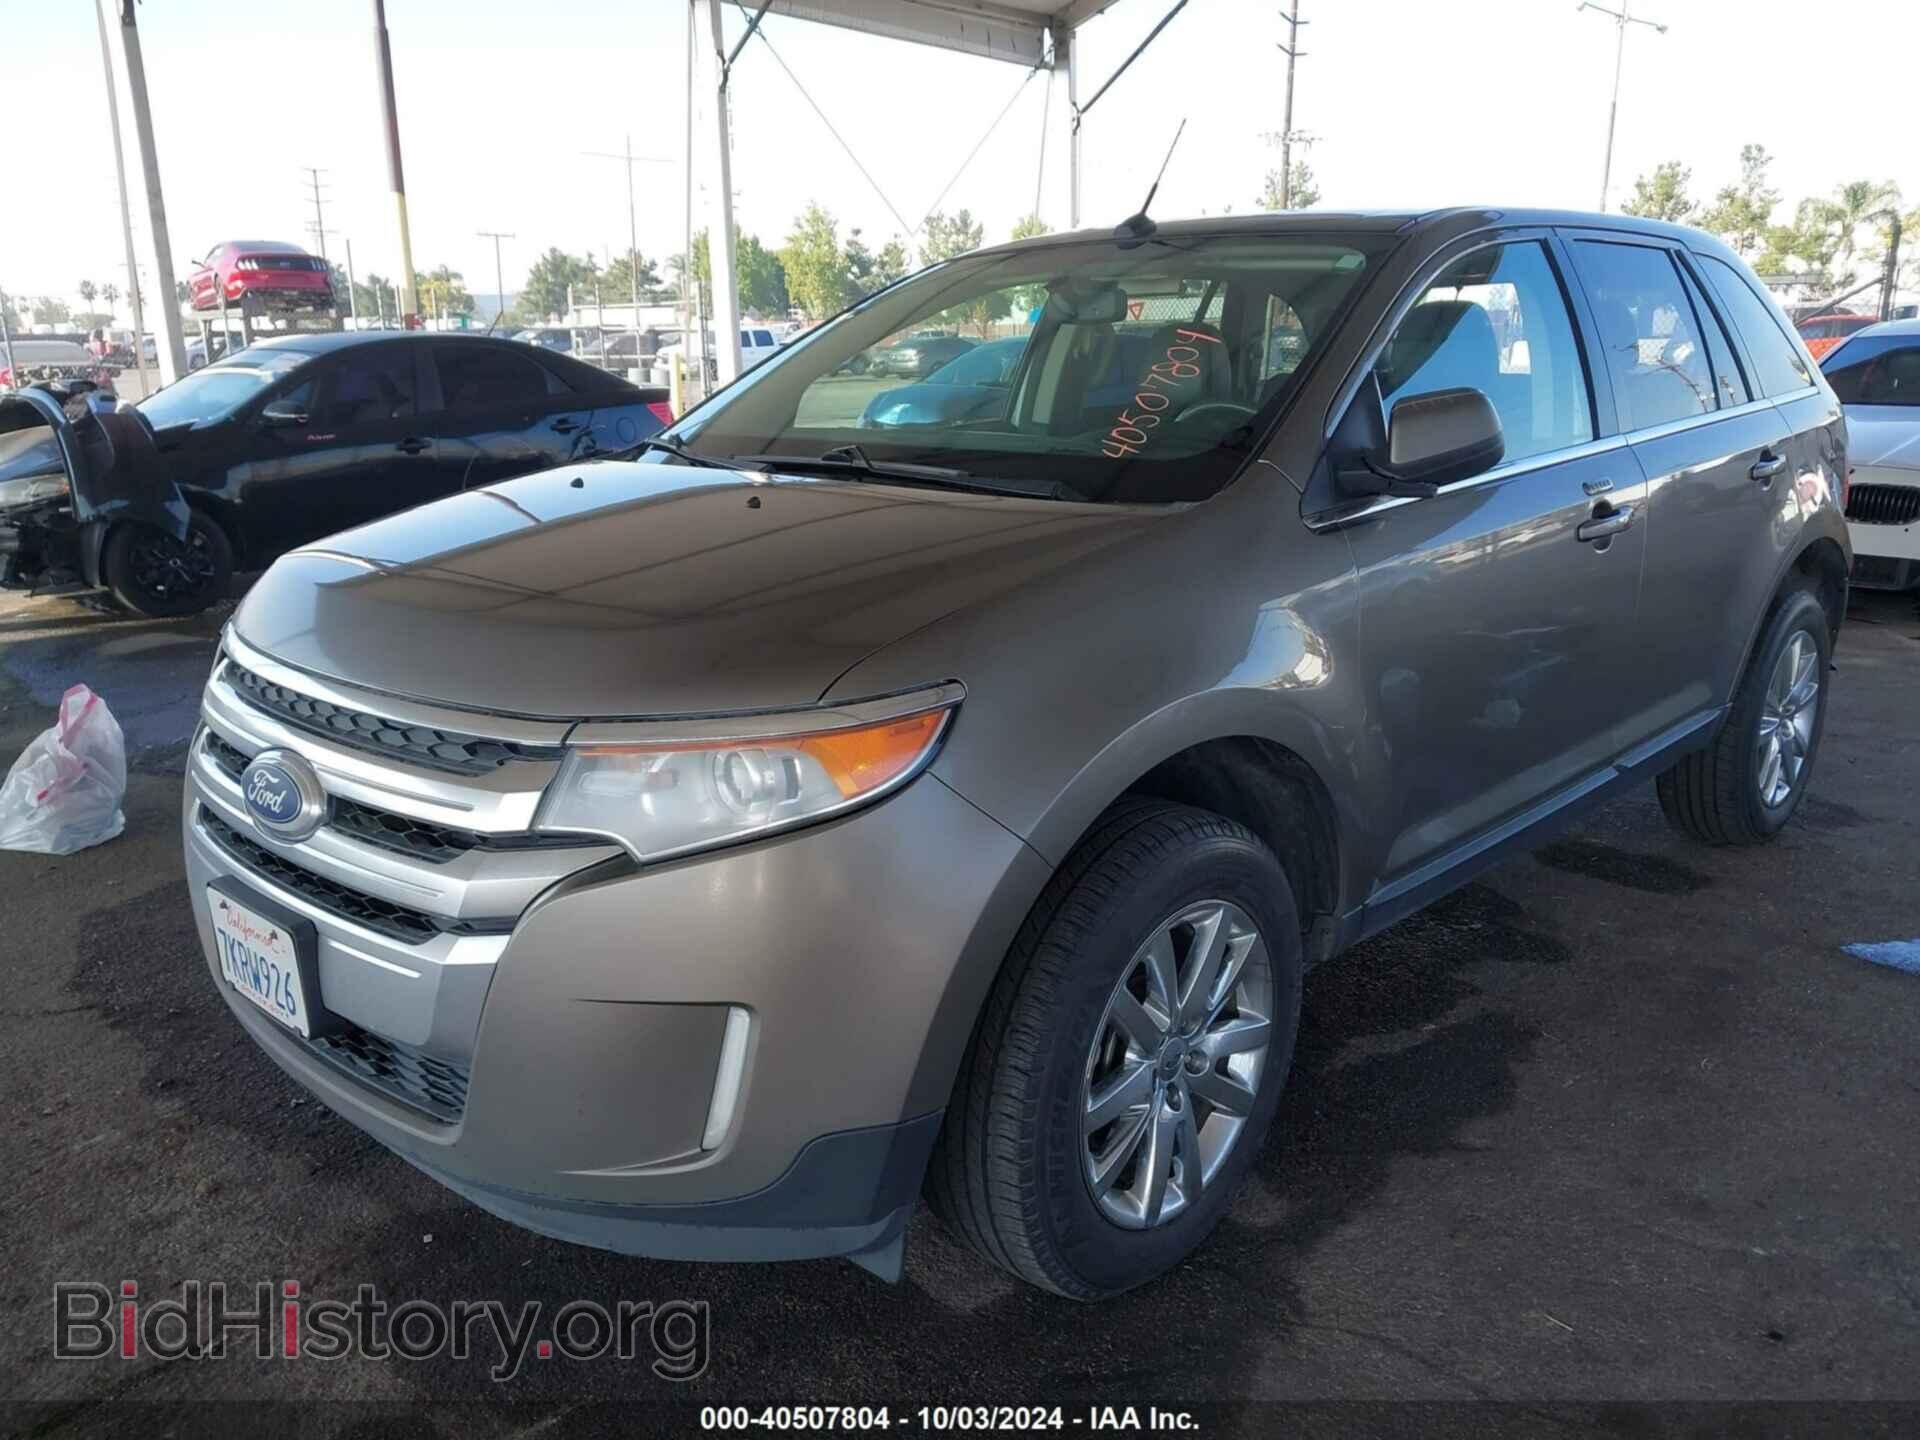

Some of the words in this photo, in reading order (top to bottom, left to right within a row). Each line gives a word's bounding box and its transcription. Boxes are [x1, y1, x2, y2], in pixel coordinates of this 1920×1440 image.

[1101, 328, 1222, 459] 40507804
[247, 769, 288, 814] Ford
[217, 926, 297, 1016] 7KRW926
